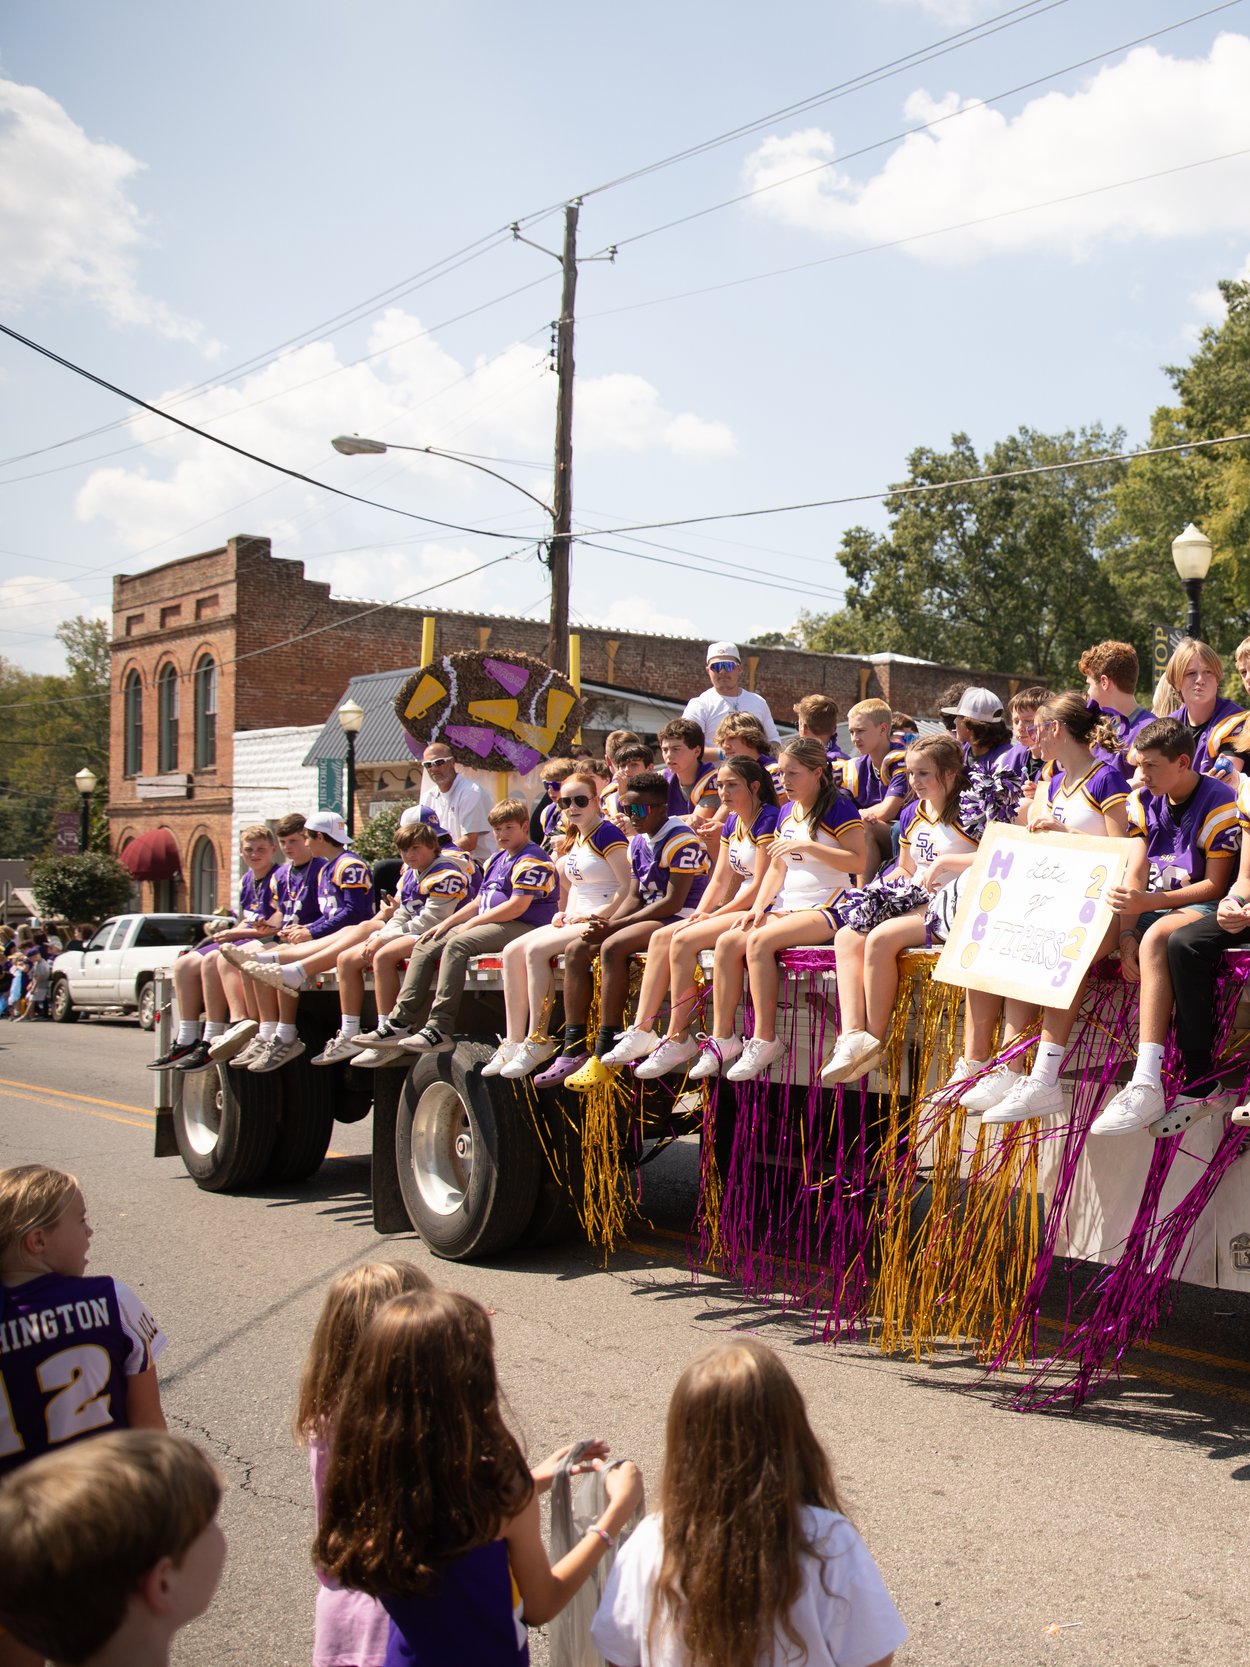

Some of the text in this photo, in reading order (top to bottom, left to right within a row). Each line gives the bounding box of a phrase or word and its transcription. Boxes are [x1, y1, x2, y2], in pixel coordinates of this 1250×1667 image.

[343, 867, 367, 884] 37
[523, 869, 548, 888] 51
[434, 877, 462, 895] 36
